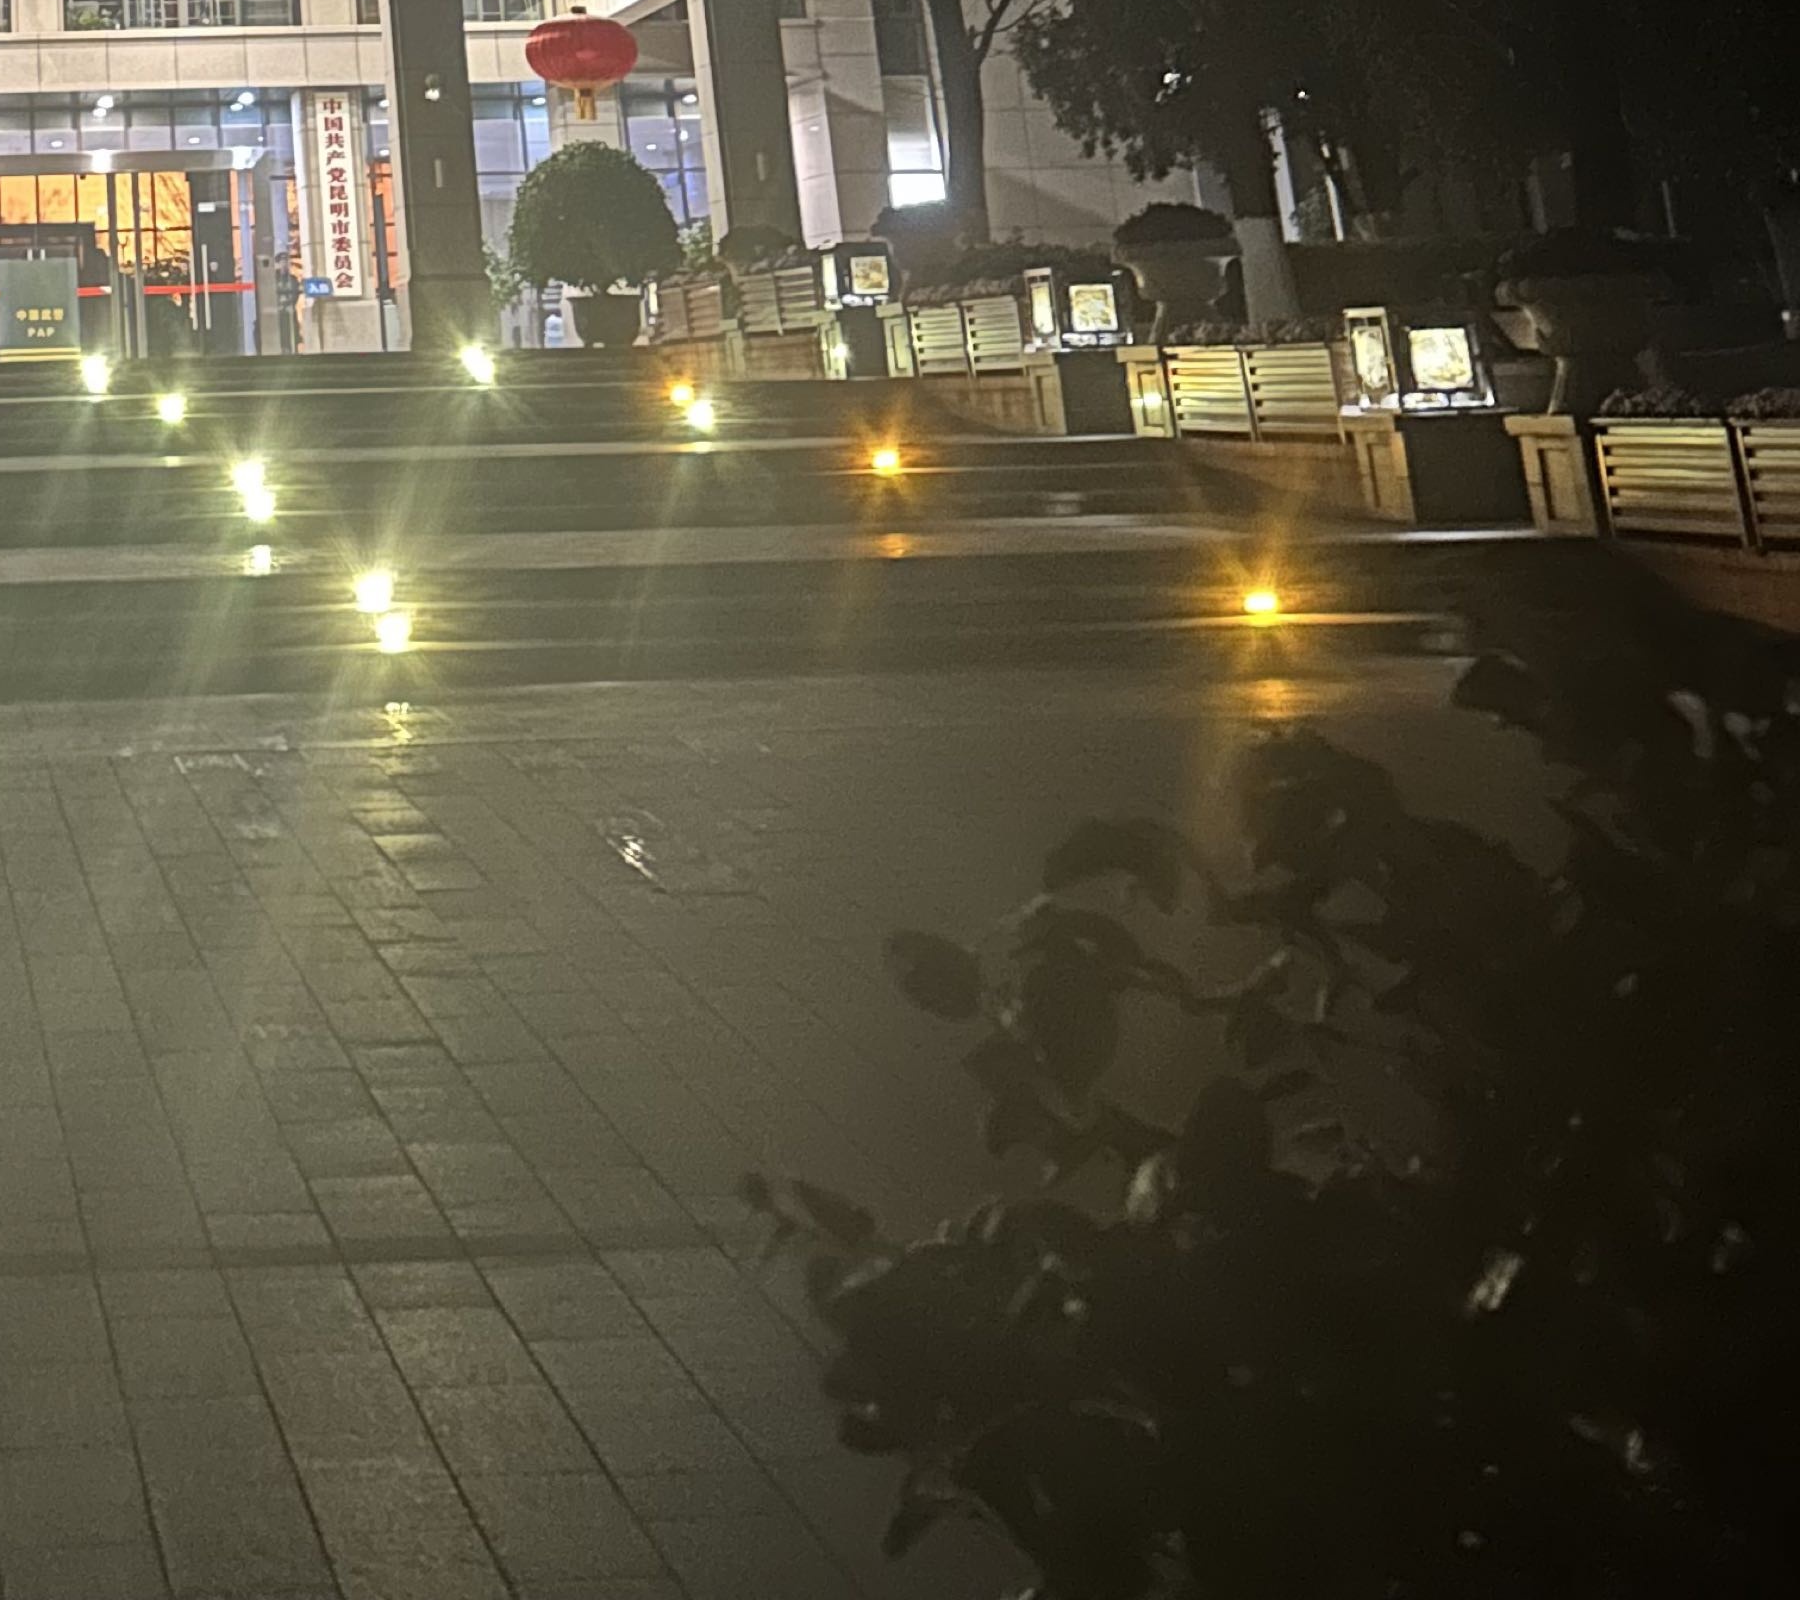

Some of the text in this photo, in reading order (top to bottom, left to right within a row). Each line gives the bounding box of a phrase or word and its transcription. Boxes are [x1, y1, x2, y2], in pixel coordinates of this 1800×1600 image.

[321, 97, 355, 290] 中国共产党昆明市委员会
